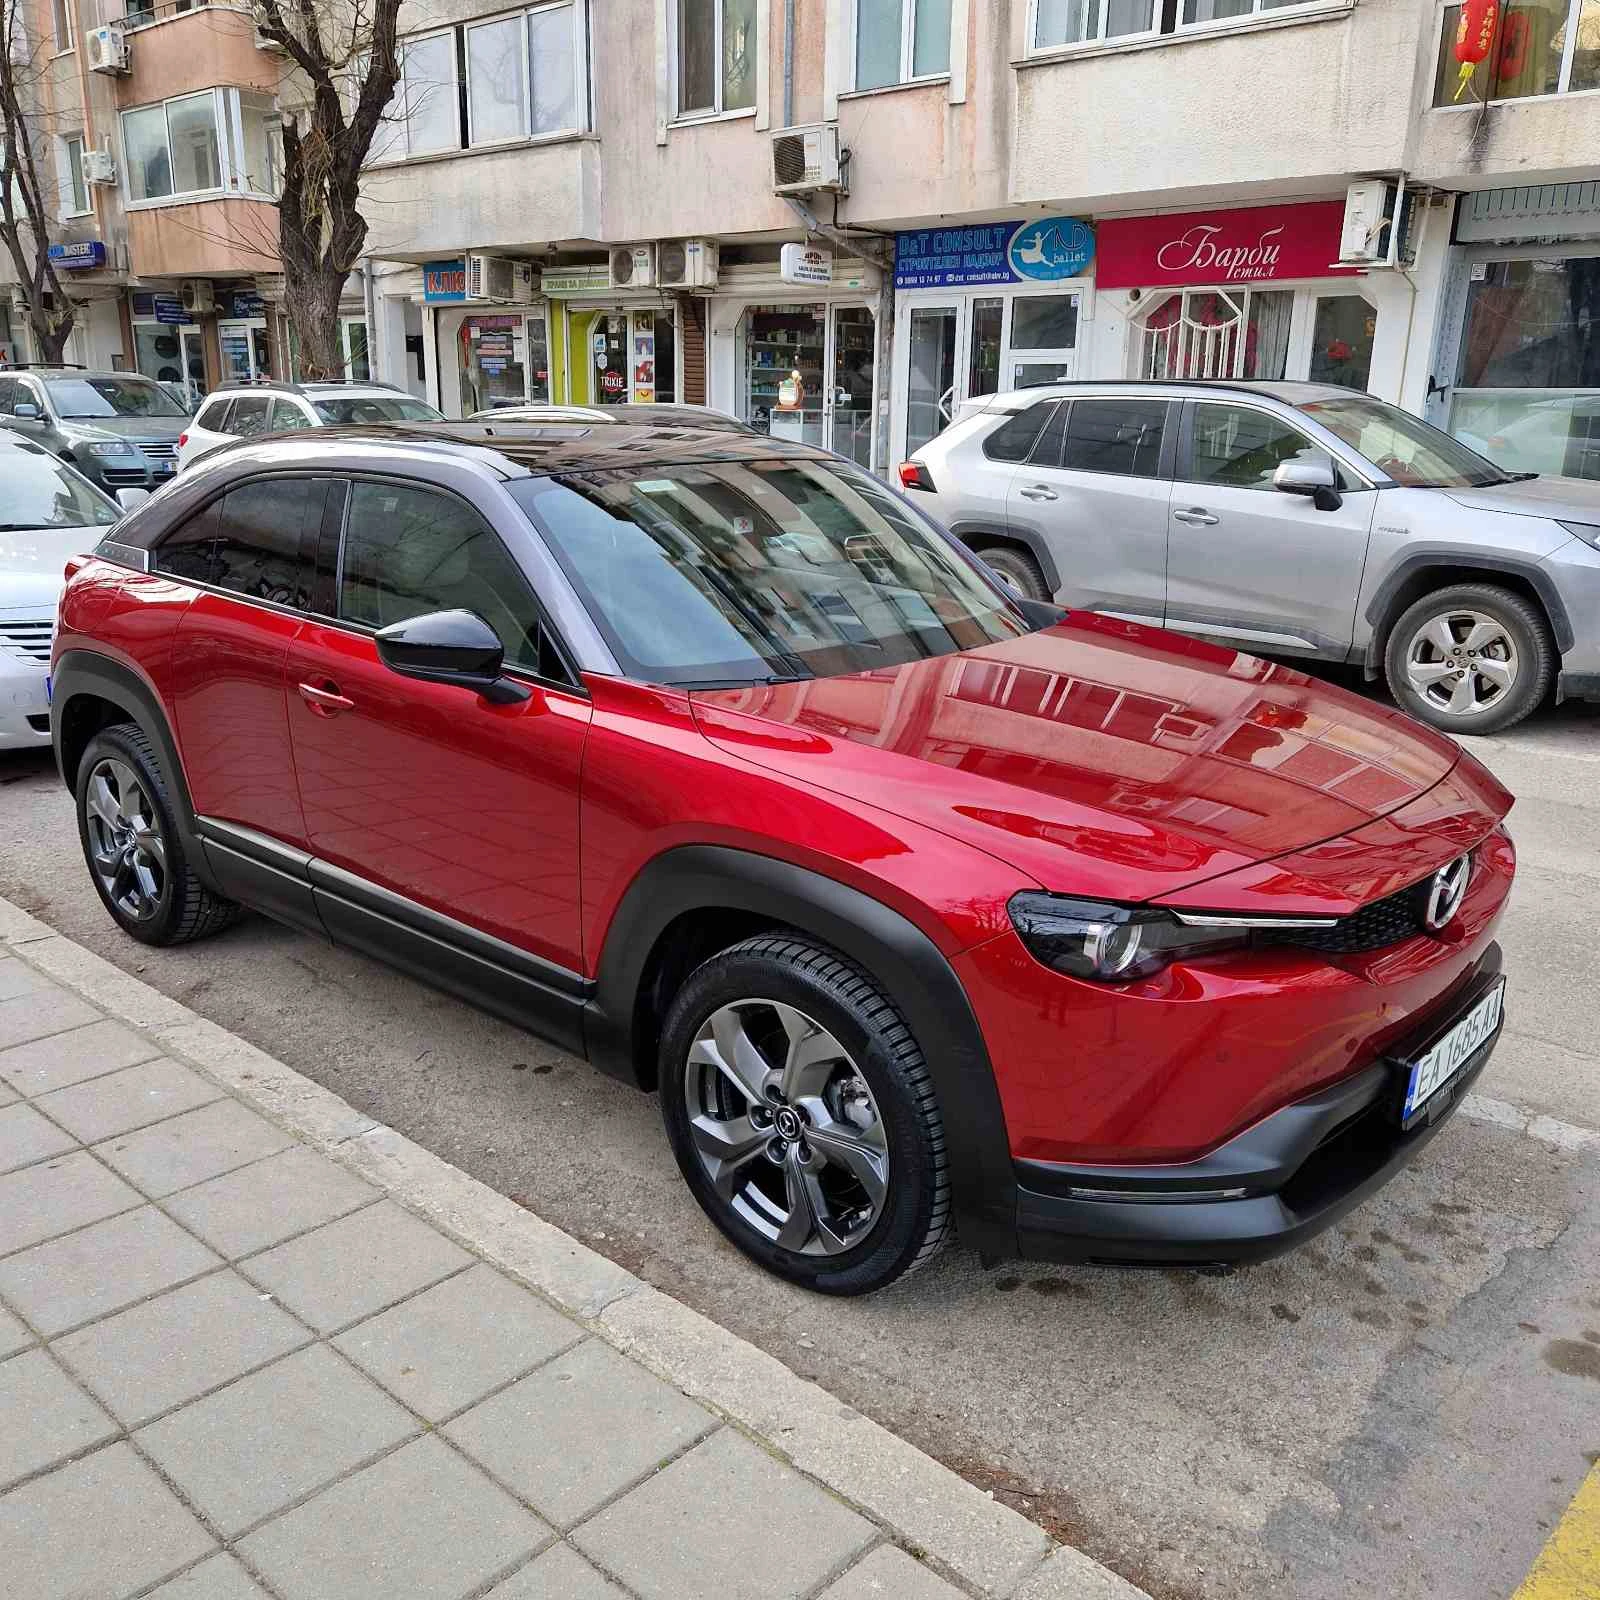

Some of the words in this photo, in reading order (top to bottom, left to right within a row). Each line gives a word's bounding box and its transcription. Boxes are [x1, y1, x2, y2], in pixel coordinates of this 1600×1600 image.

[933, 227, 1005, 252] CONSULT
[1157, 224, 1285, 279] Барби
[600, 376, 624, 388] TRIXIE
[1418, 1049, 1441, 1098] EA
[1446, 1008, 1483, 1073] 1685
